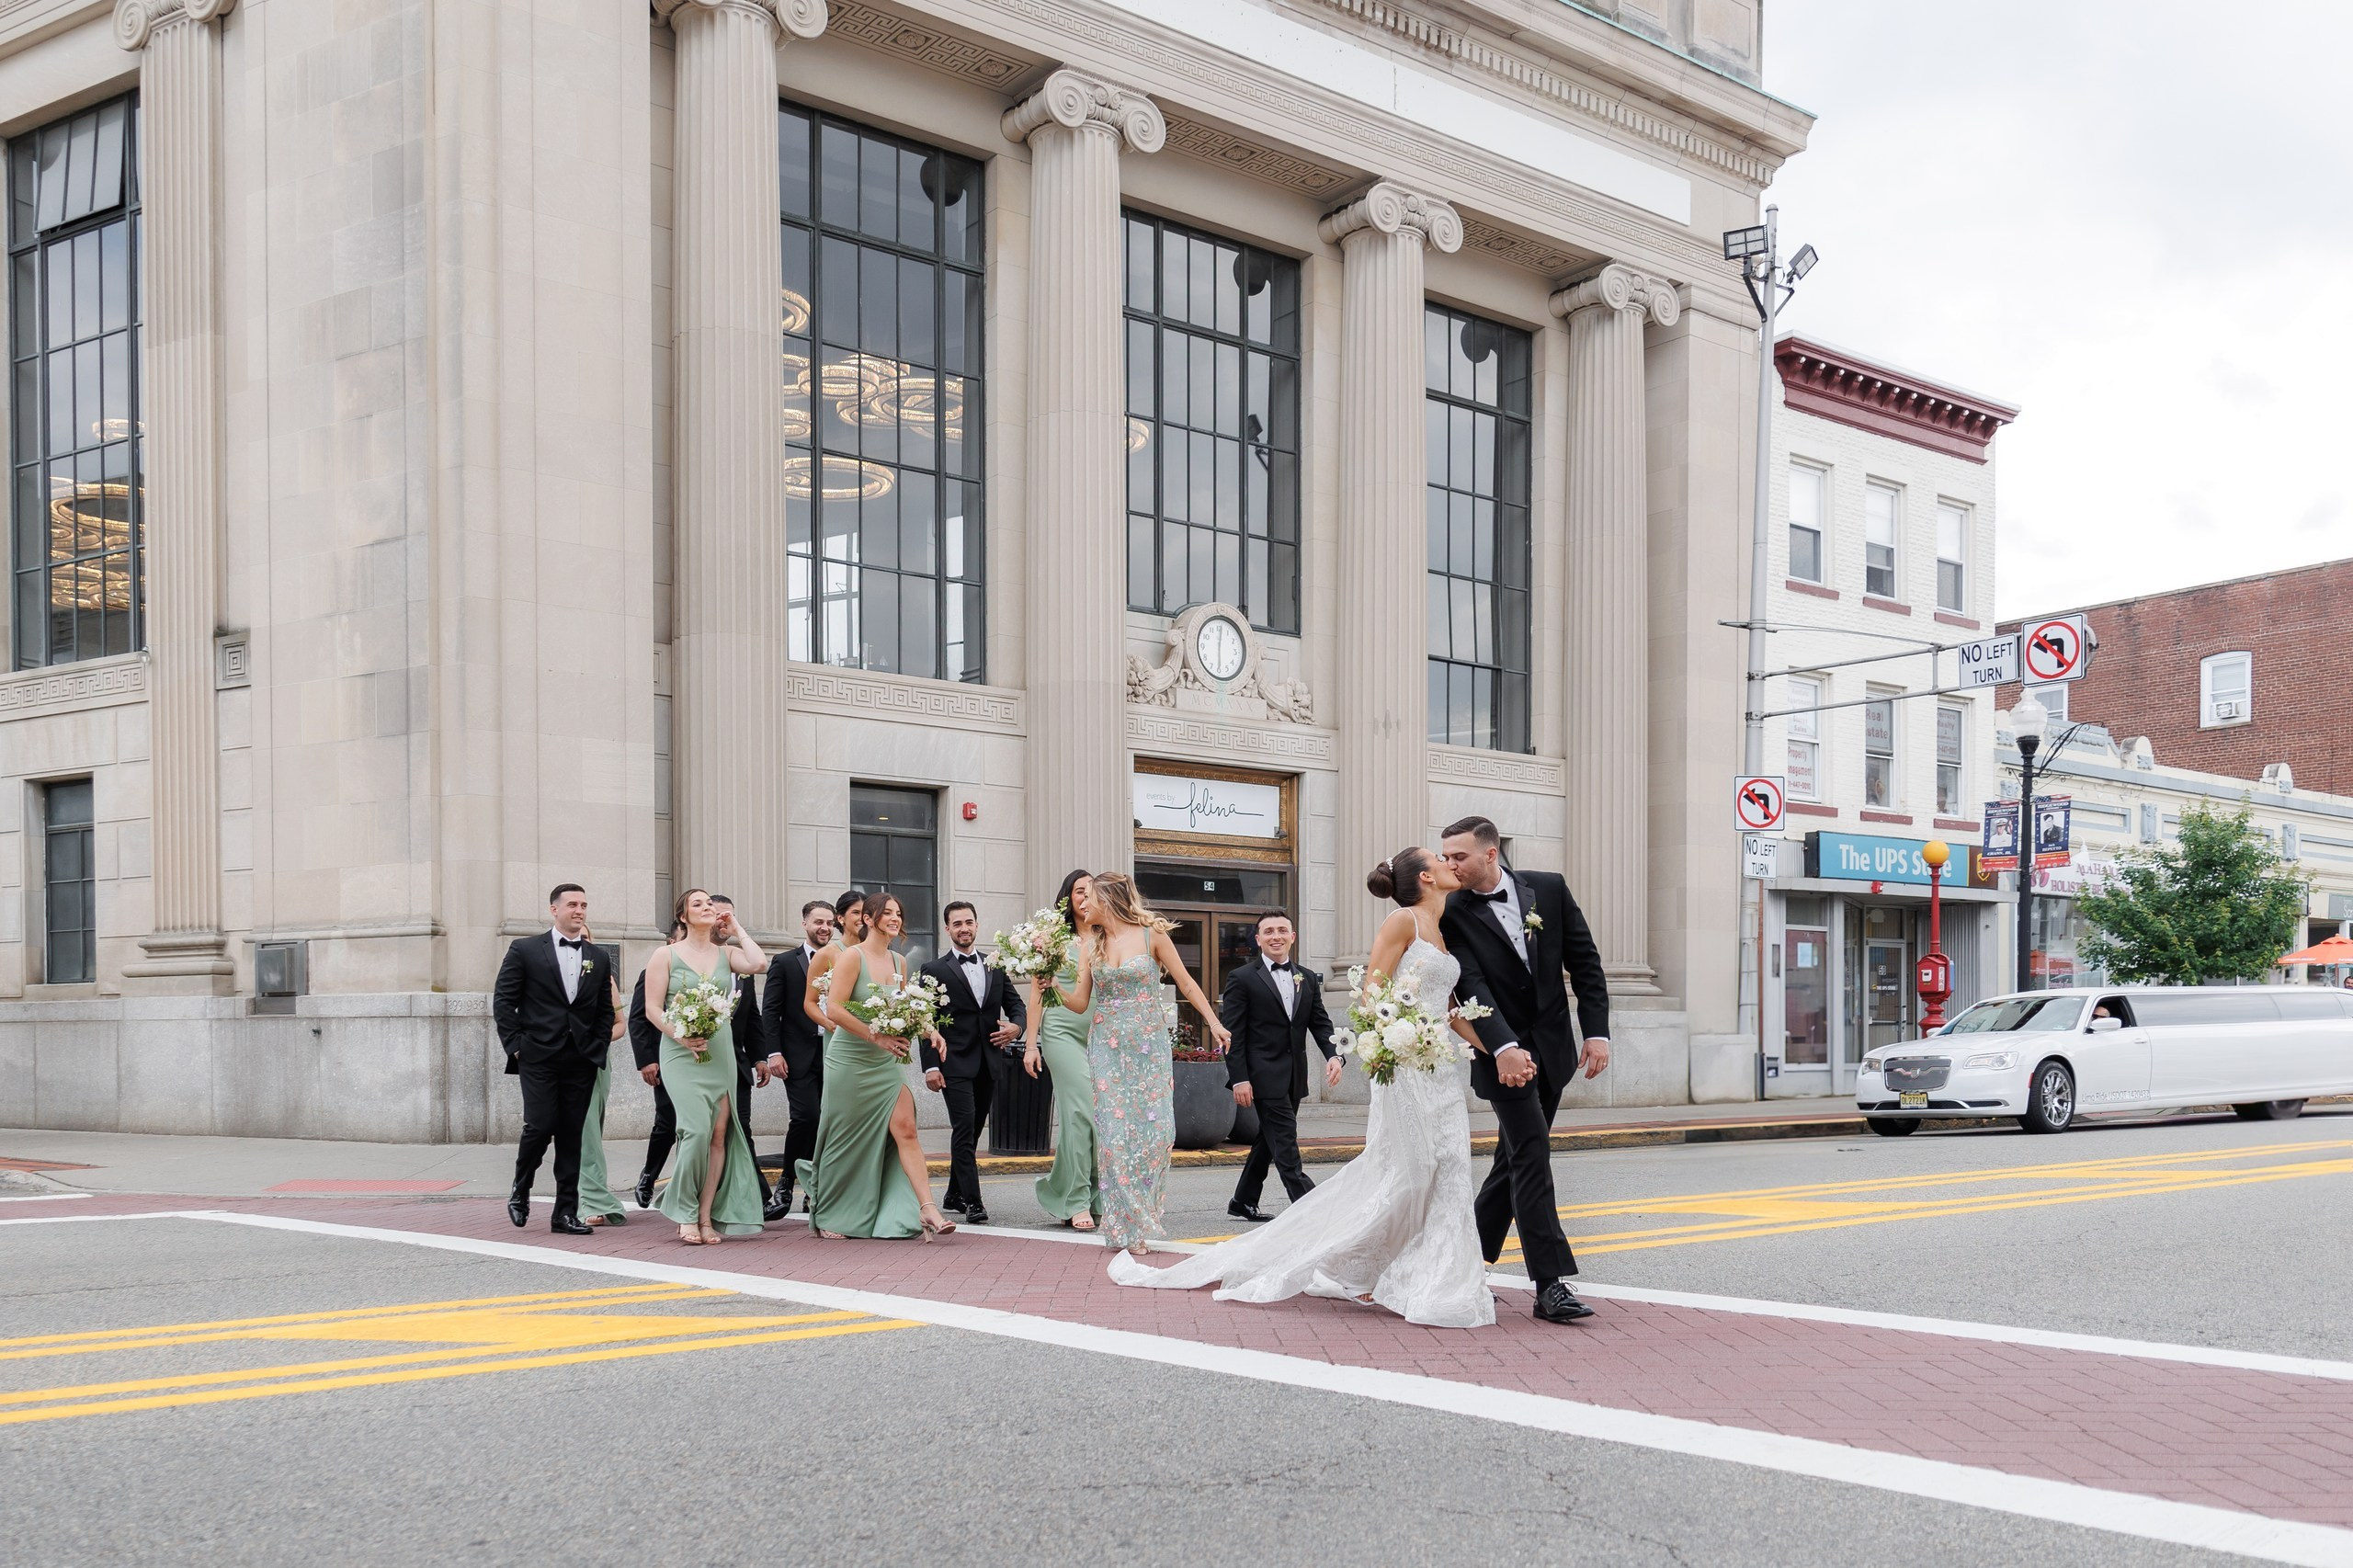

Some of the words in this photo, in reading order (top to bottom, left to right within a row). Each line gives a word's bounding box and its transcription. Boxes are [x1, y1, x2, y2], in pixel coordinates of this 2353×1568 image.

[1961, 644, 1982, 665] NO
[1986, 642, 2013, 660] LEFT
[1972, 666, 2002, 684] TURN
[1866, 709, 1883, 722] Real
[1867, 727, 1888, 740] state
[1146, 792, 1165, 801] events
[1167, 791, 1176, 804] by
[1154, 782, 1264, 828] felina
[1746, 838, 1757, 855] NO
[1760, 844, 1776, 857] LEFT
[1752, 862, 1768, 876] TURN
[1839, 844, 1870, 871] The
[1875, 847, 1907, 874] UPS
[1912, 850, 1952, 878] Ste
[1205, 881, 1214, 890] 54
